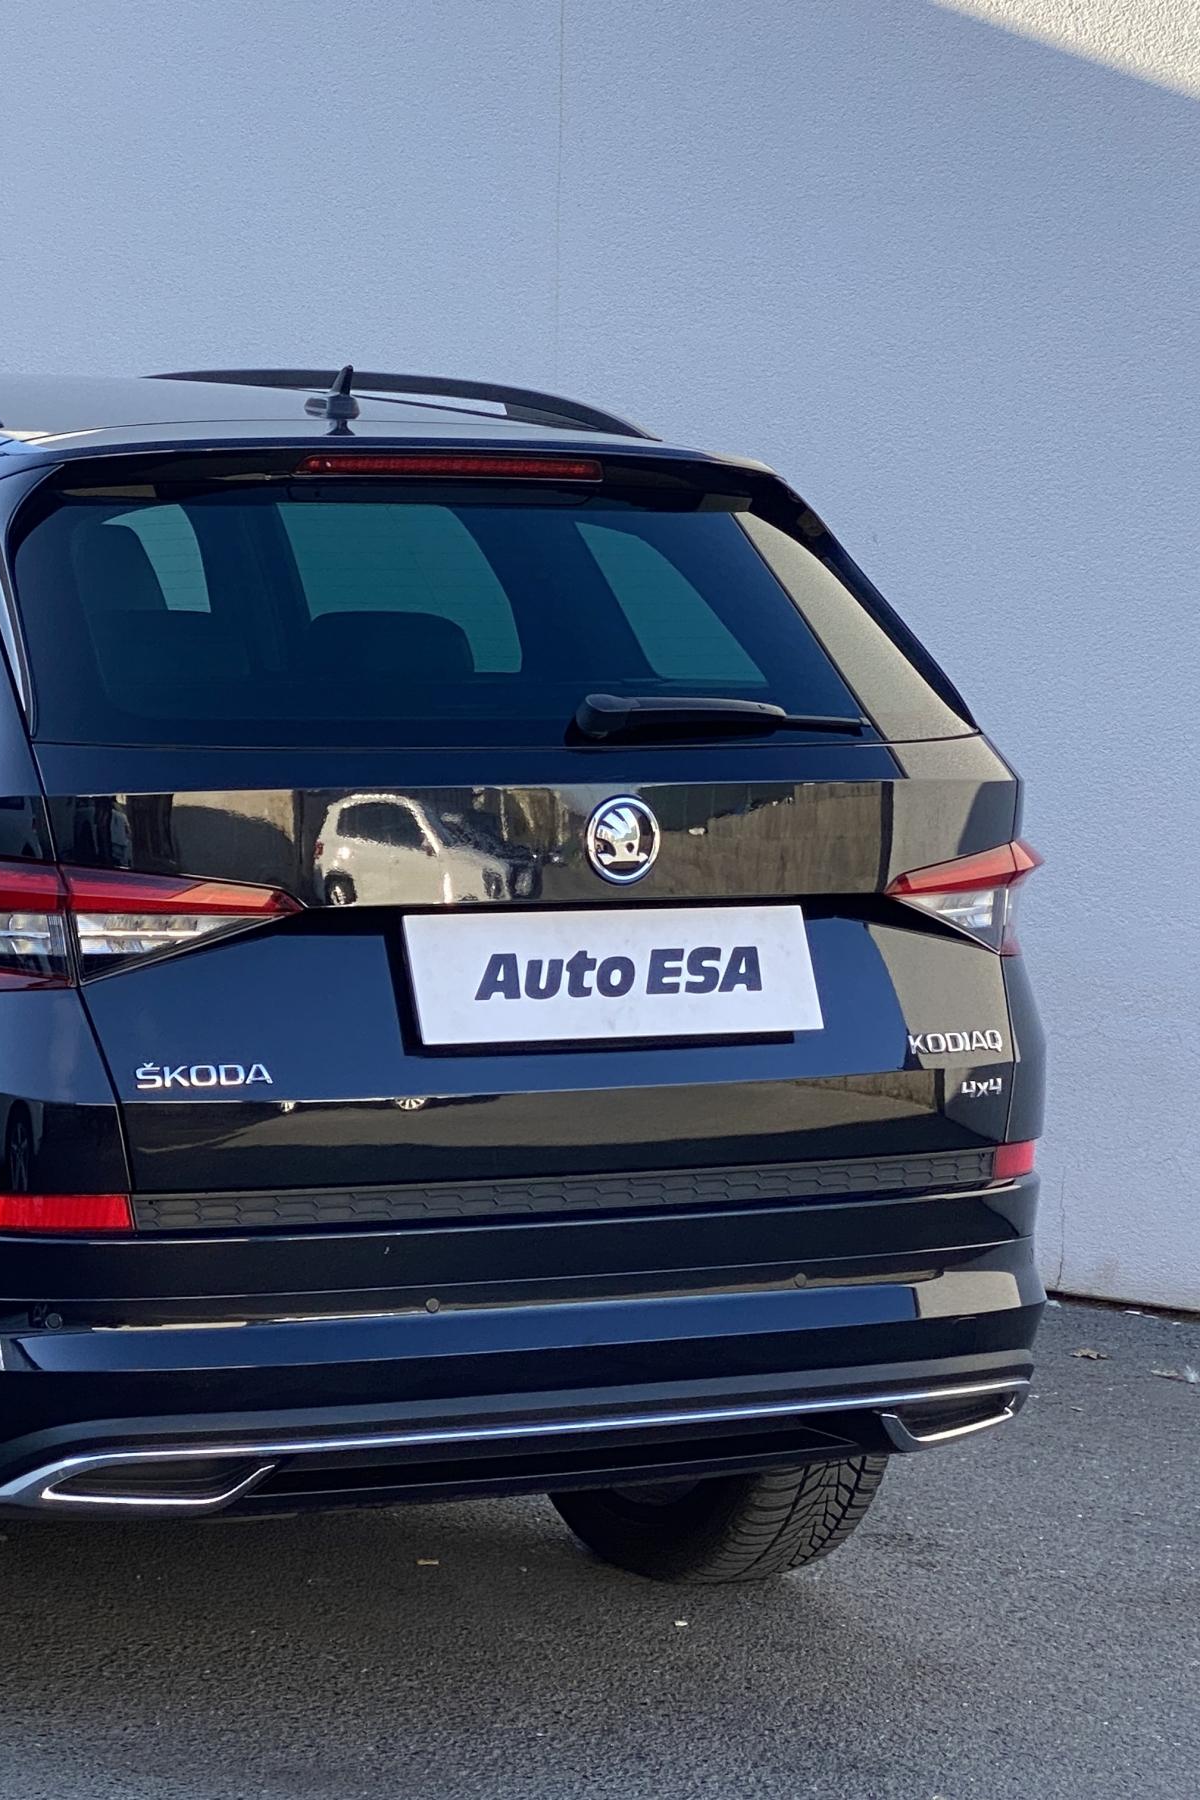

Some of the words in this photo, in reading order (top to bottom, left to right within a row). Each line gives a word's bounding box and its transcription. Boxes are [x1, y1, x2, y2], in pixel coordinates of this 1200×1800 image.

[474, 950, 635, 1001] Auto
[645, 946, 763, 995] ESA
[907, 1029, 1003, 1054] KODIAQ
[135, 1062, 274, 1089] ŠKODA
[961, 1078, 1002, 1098] 4x4
